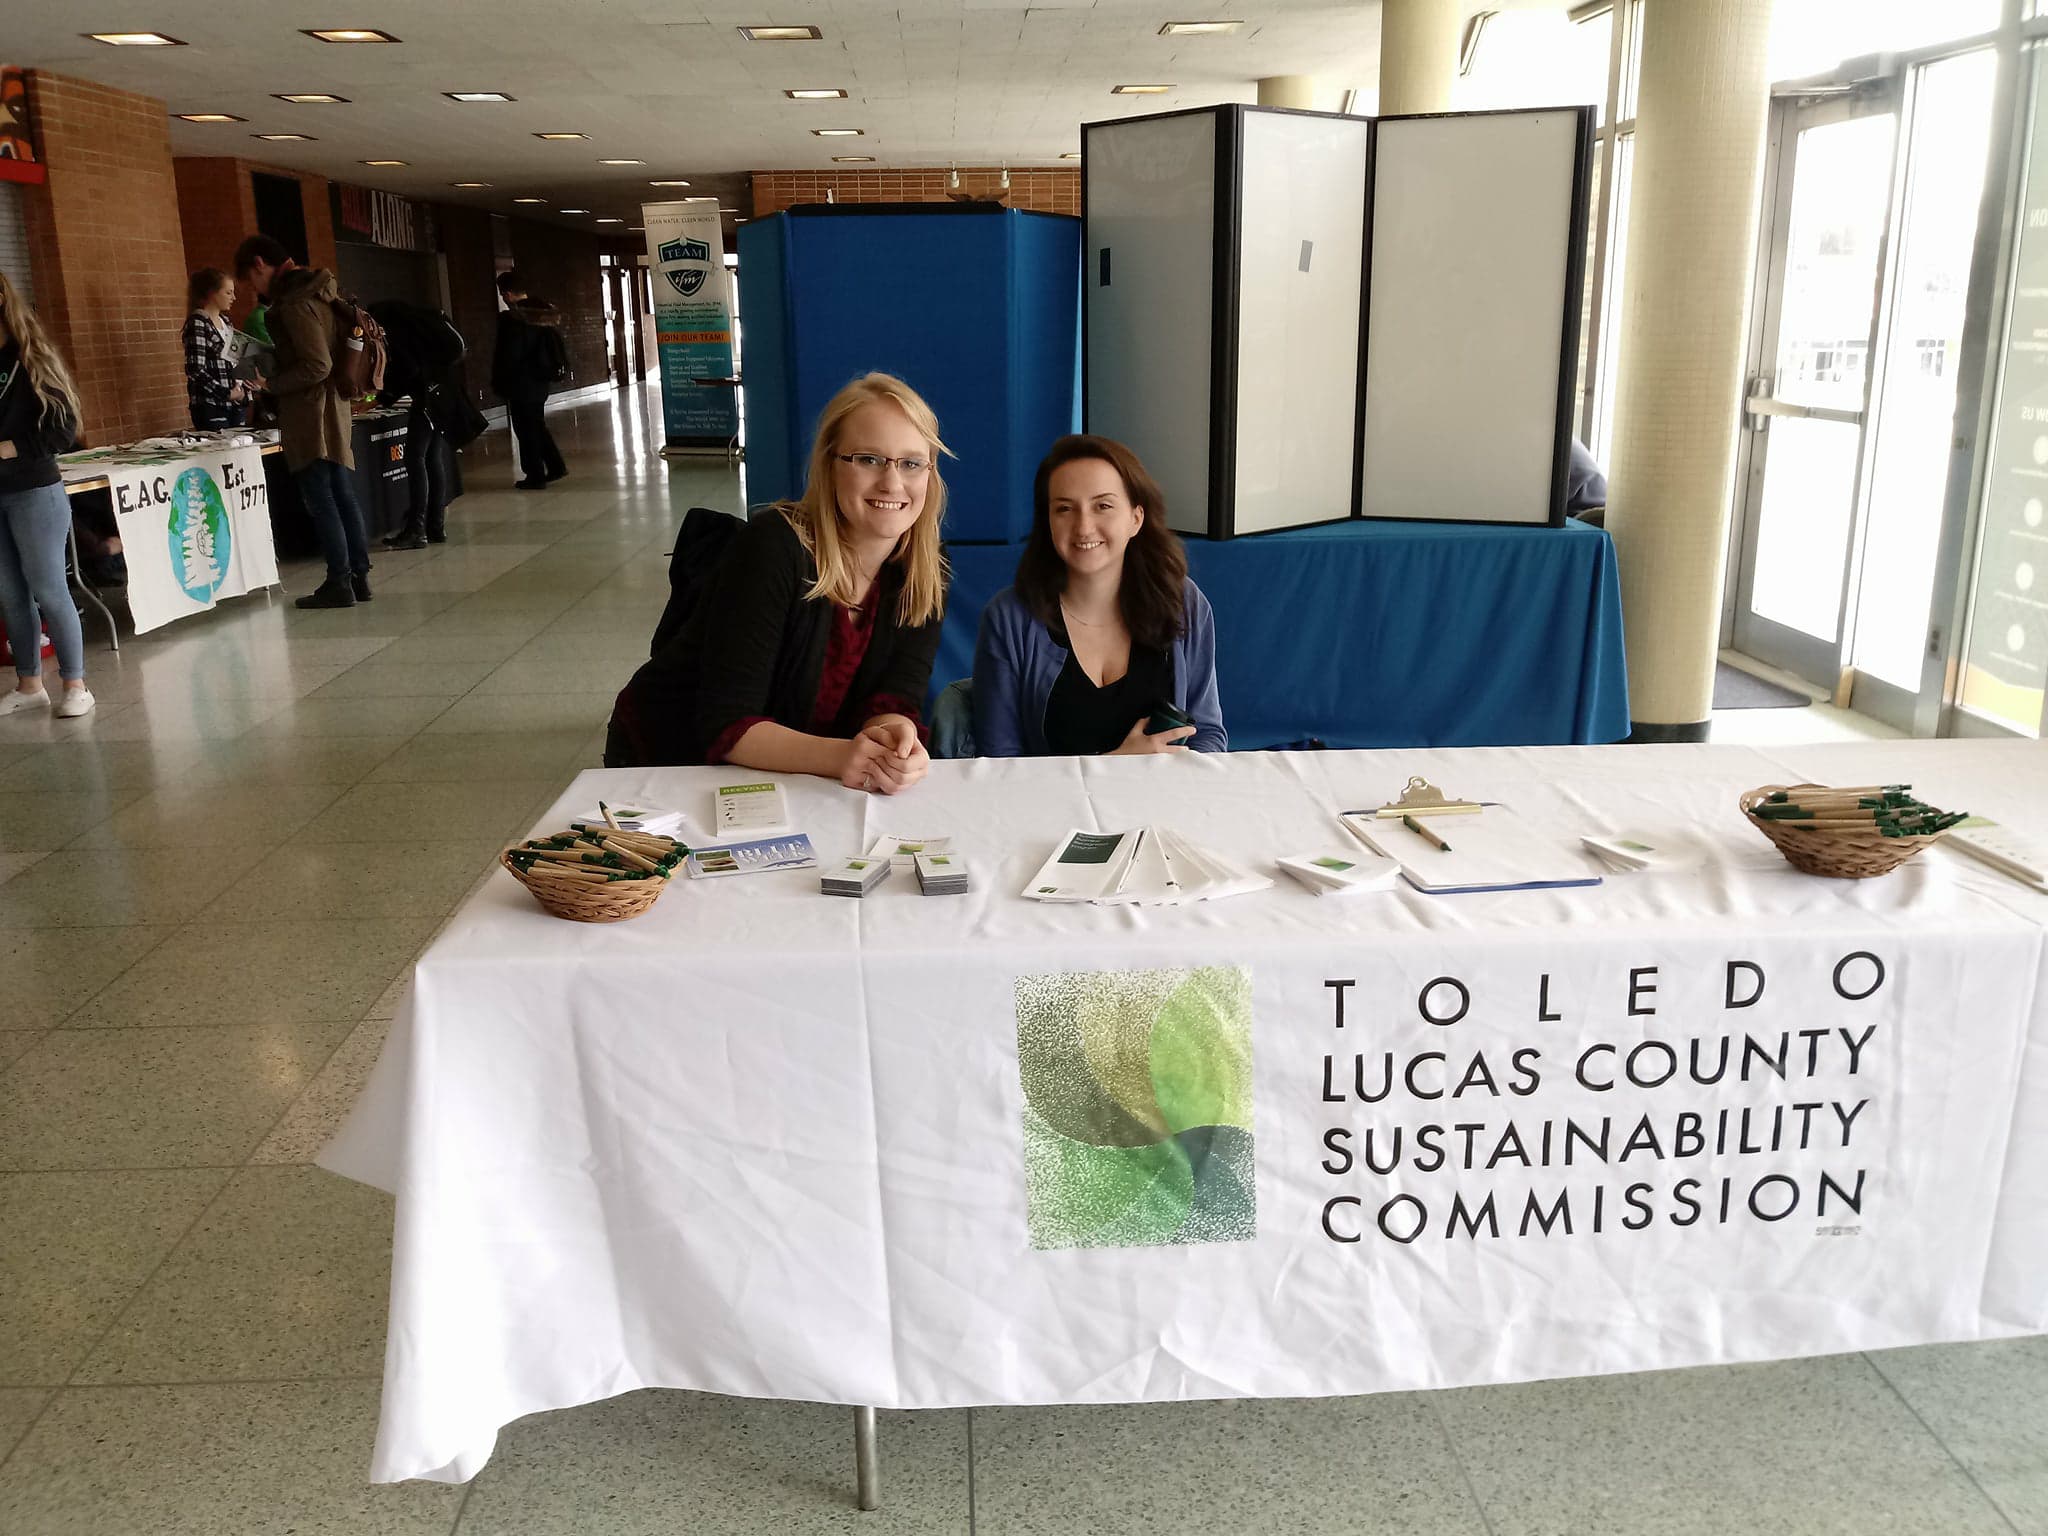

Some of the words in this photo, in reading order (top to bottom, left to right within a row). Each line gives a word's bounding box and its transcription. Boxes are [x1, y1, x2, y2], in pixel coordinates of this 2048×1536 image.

[371, 190, 415, 249] ALONG
[664, 247, 703, 259] TEAM
[660, 333, 679, 343] JOIN
[239, 483, 266, 511] 1977
[1323, 950, 1886, 1029] TOLEDO
[1322, 1047, 1542, 1103] LUCAS
[1574, 1024, 1878, 1092] COUNTY
[1321, 1098, 1870, 1175] SUSTAINABILITY
[1321, 1168, 1867, 1244] COMMISSION
